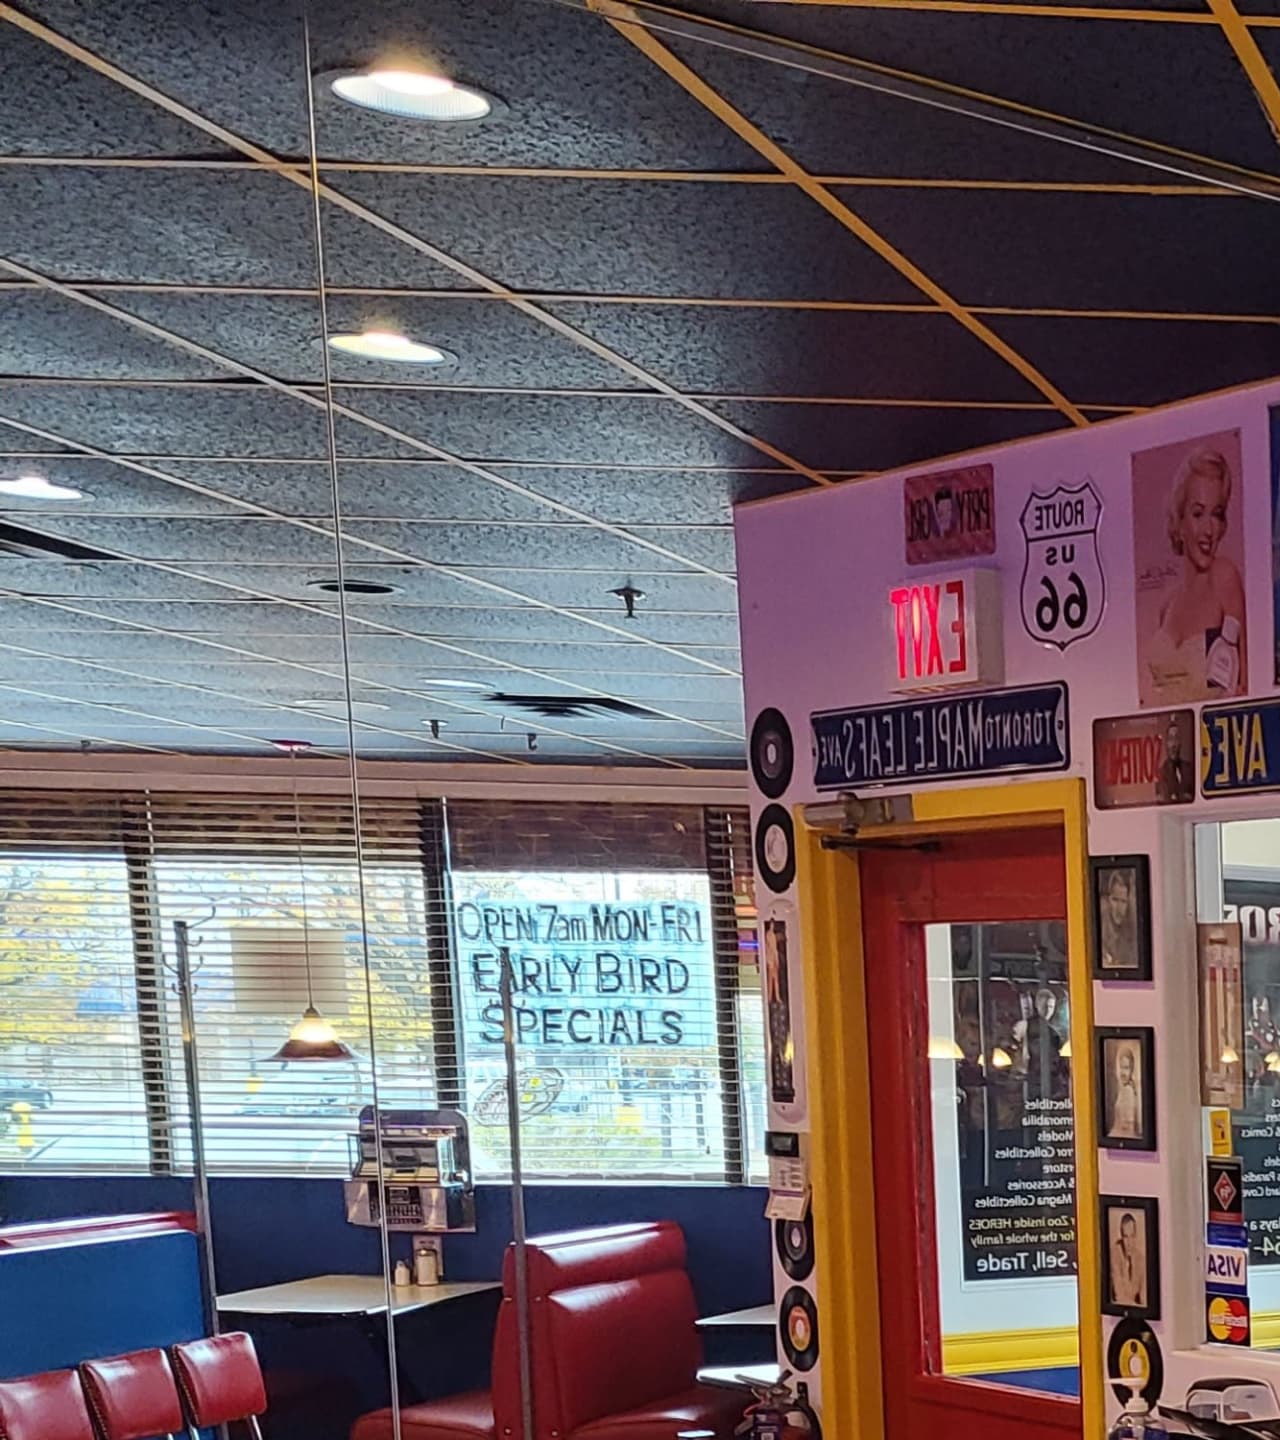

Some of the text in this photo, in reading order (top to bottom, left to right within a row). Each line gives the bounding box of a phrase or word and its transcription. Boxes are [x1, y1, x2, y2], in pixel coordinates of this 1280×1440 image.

[457, 902, 703, 942] OPEN 7am MON-FRI
[472, 953, 690, 994] EARLY BIRD
[480, 1008, 683, 1045] SPECIALS
